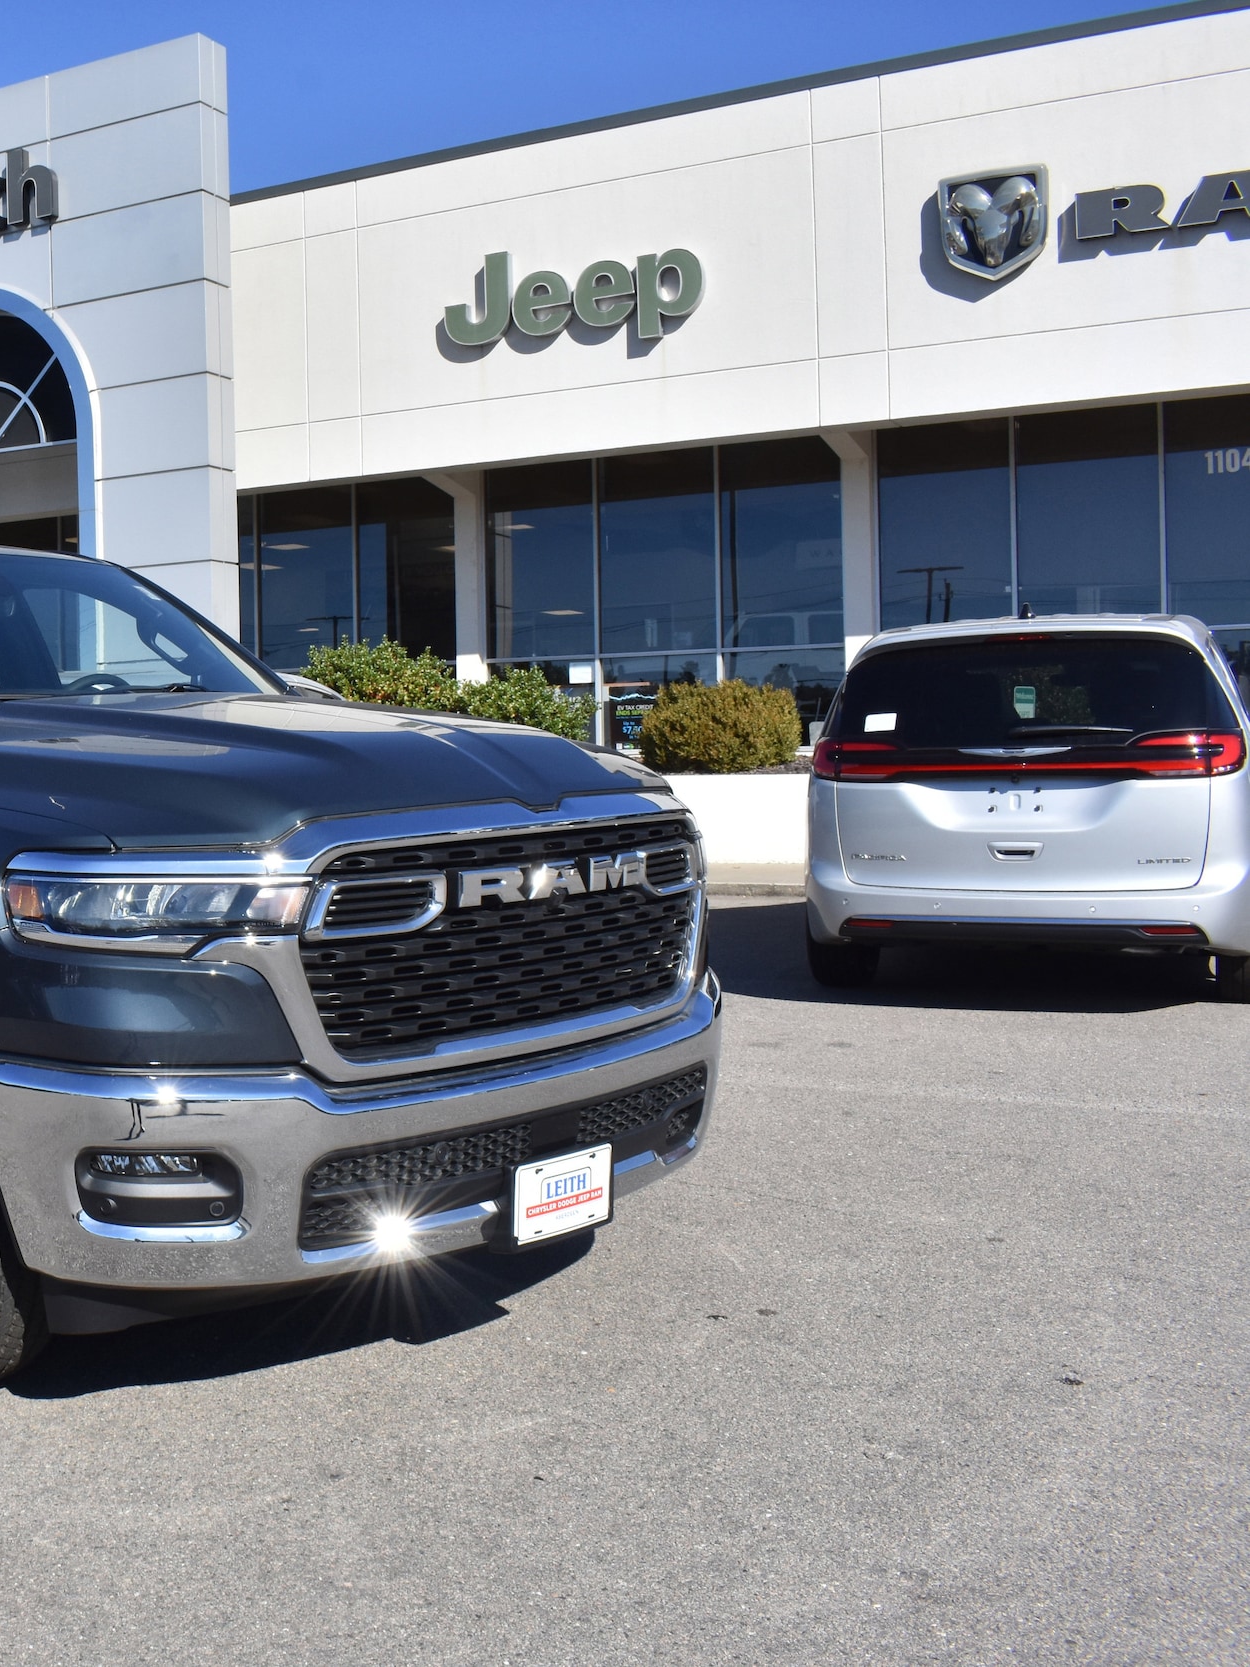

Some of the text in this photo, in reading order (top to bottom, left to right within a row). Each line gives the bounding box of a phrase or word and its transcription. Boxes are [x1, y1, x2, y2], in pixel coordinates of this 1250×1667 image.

[444, 248, 707, 346] Jeep
[1204, 447, 1250, 474] 1104
[1137, 857, 1192, 865] LIMITED
[458, 850, 643, 908] RAM
[546, 1173, 587, 1199] LEITH
[527, 1189, 602, 1216] CHRYSLER DODGE JEEP RAM
